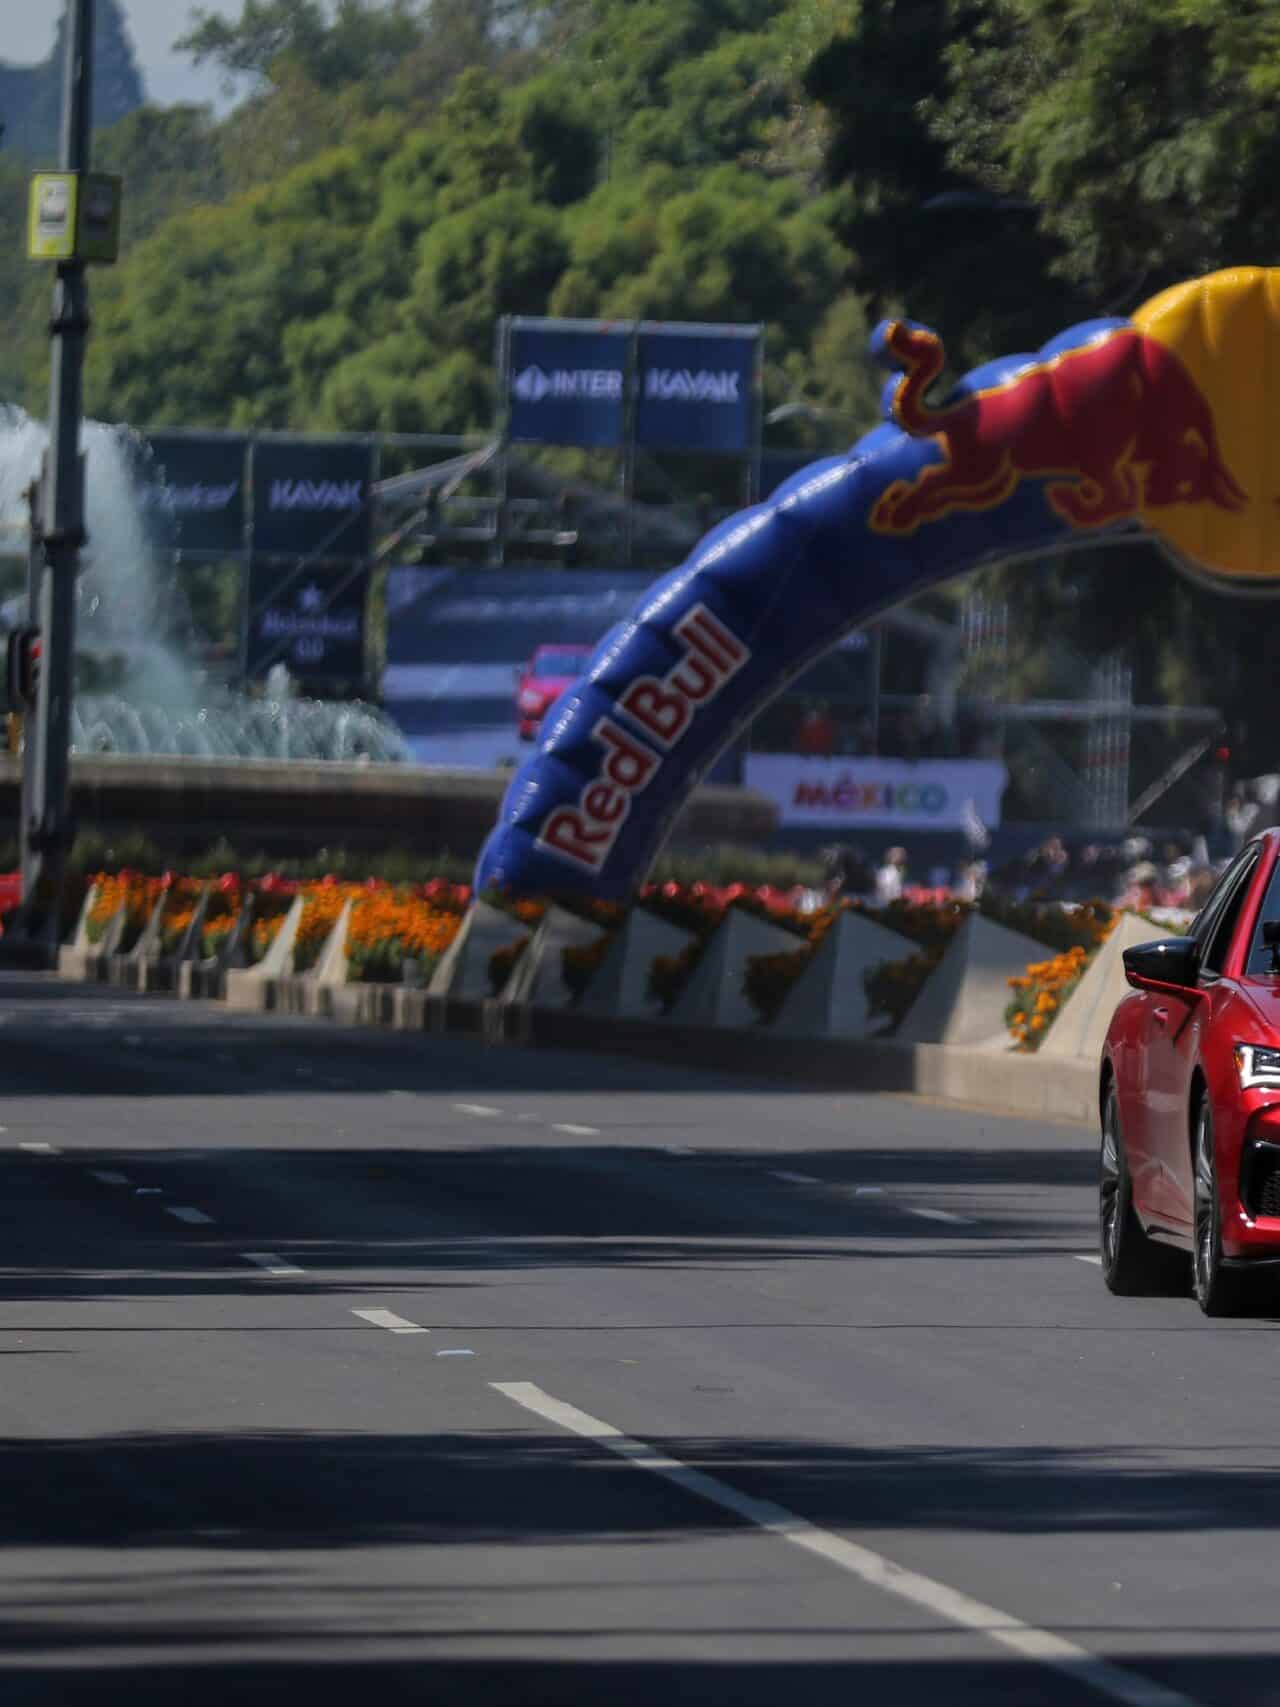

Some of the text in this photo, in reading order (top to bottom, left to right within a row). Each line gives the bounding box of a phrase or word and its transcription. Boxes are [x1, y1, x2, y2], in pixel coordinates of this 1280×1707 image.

[553, 369, 623, 399] INTER
[645, 368, 740, 402] KAVAK
[270, 481, 362, 506] KAVAK
[533, 715, 664, 873] Red
[613, 602, 752, 750] Bull
